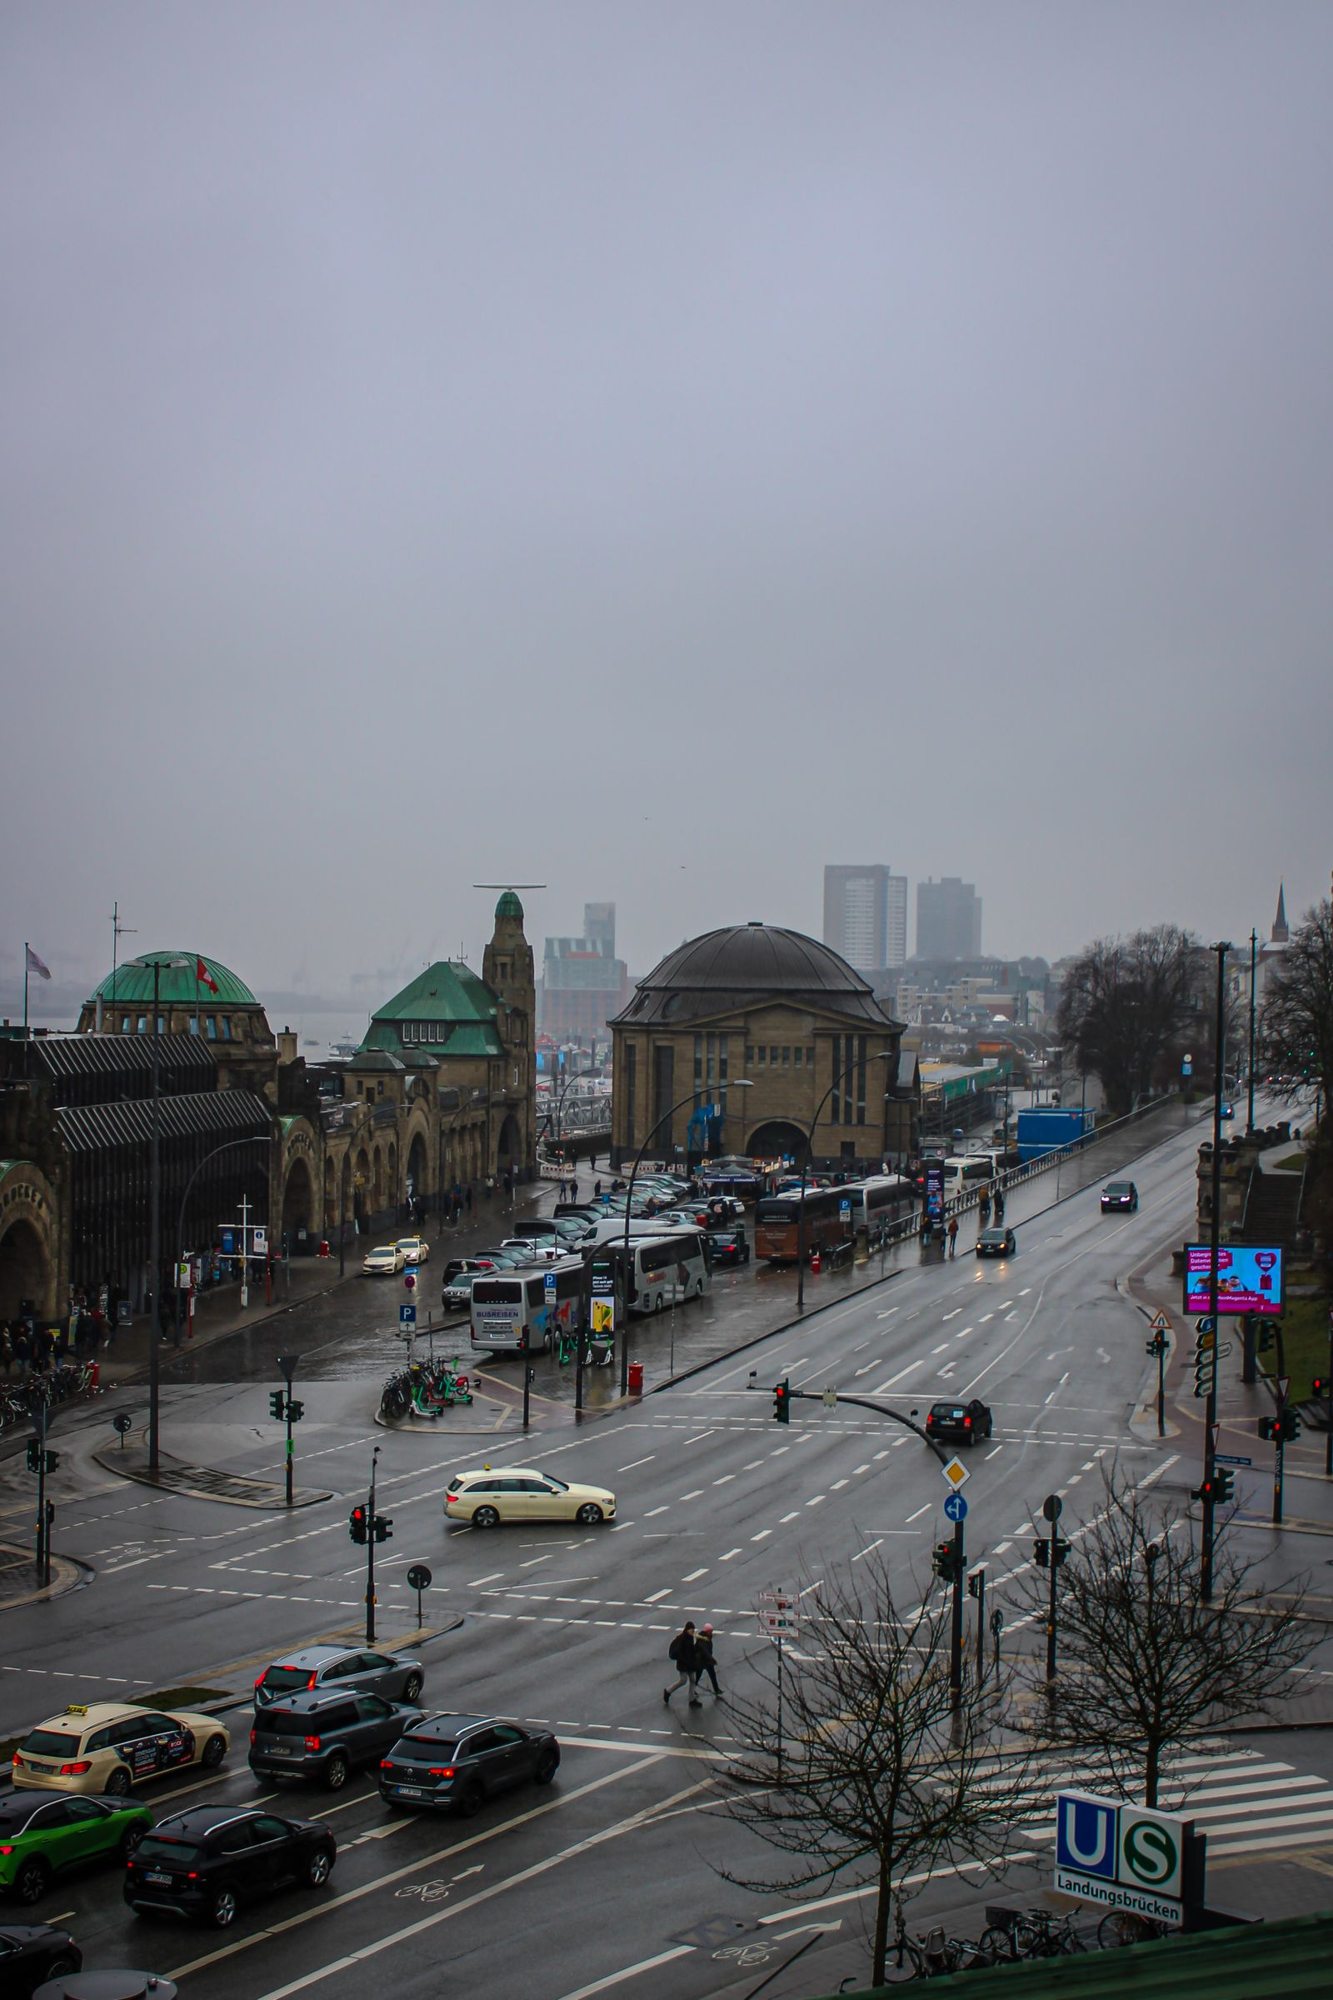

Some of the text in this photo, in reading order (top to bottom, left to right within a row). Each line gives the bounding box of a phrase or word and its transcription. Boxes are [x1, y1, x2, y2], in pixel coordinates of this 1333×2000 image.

[842, 1201, 848, 1209] P
[546, 1275, 553, 1286] P
[403, 1307, 412, 1320] P
[1066, 1802, 1169, 1881] U S
[1057, 1873, 1180, 1921] Landungsbrücken
